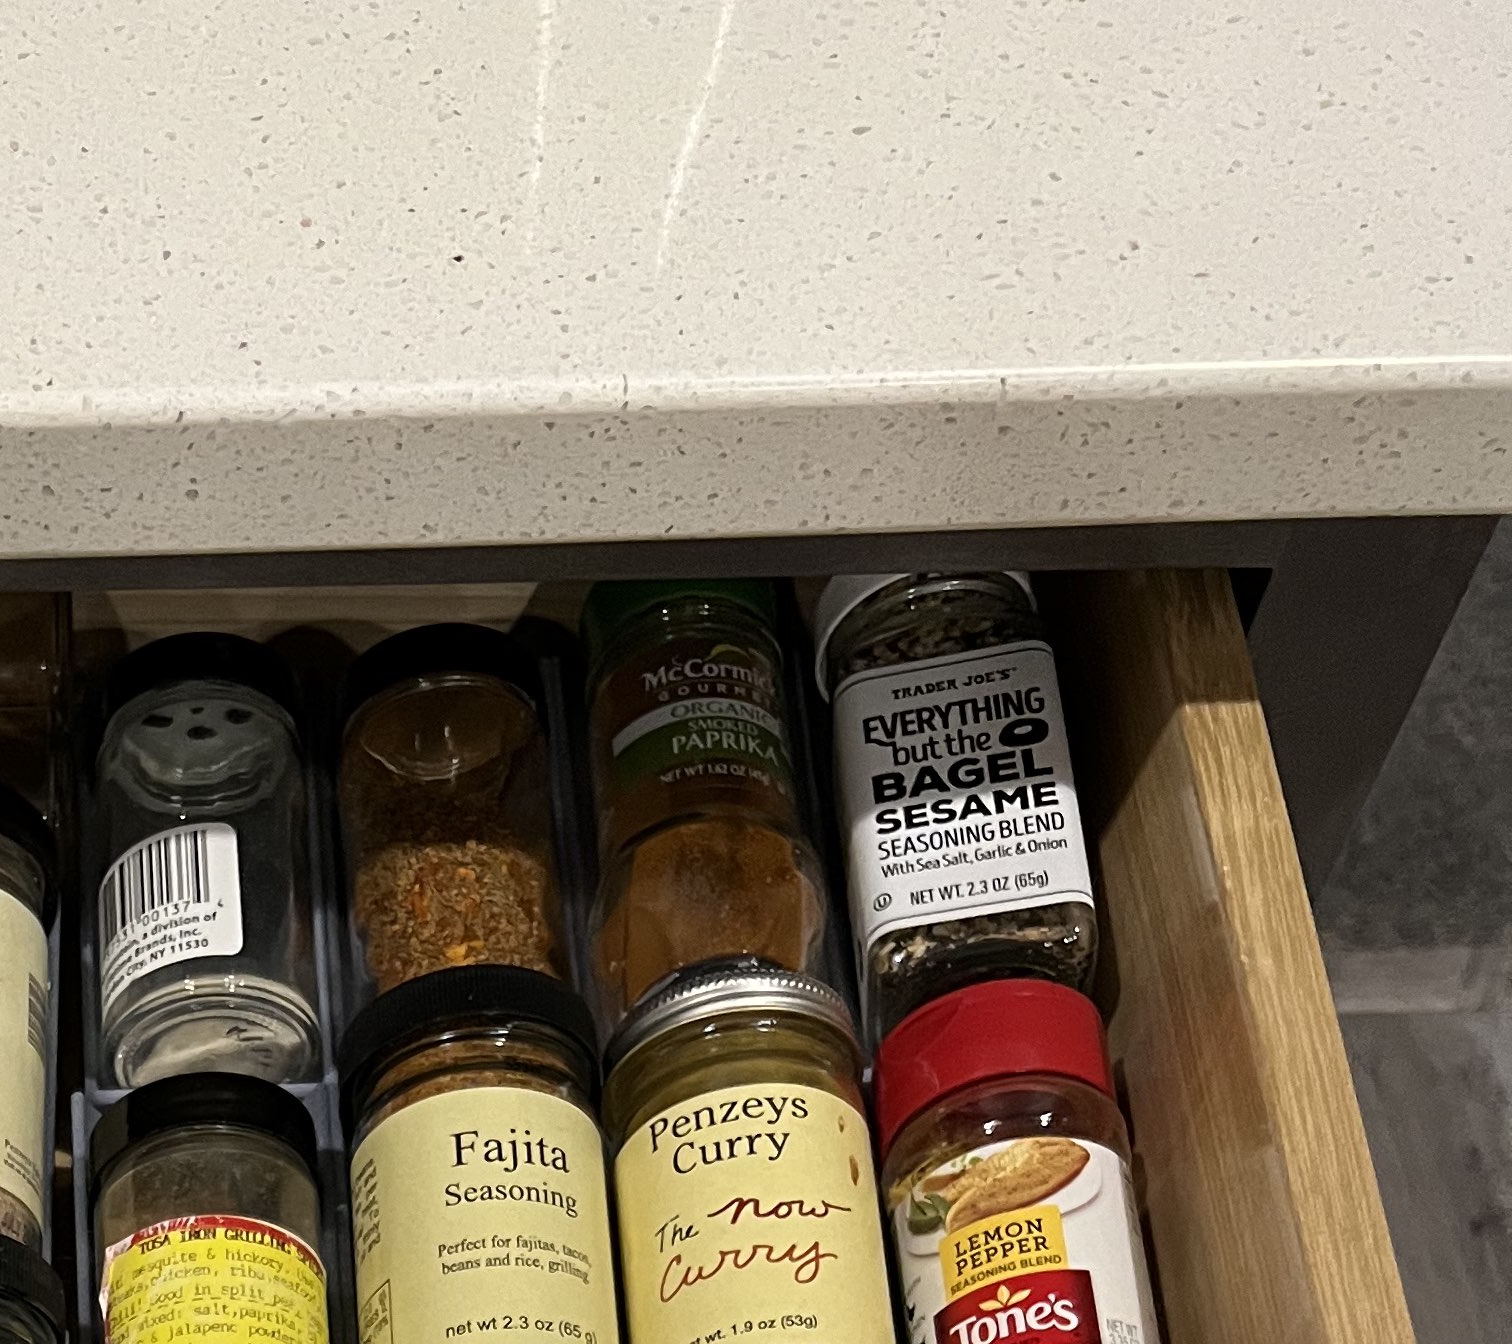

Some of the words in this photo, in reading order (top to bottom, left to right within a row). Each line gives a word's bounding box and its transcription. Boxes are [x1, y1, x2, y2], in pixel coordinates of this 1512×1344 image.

[892, 678, 958, 700] TRADER
[862, 687, 1045, 748] EVERYTHING
[672, 732, 779, 766] PAPRIKA
[892, 737, 943, 766] but
[944, 728, 992, 759] the
[871, 748, 1053, 804] BAGEL
[875, 781, 1058, 835] SESAME
[878, 821, 996, 860] SEASONING
[999, 811, 1065, 839] BLEND
[881, 862, 915, 878] With
[917, 857, 942, 873] Sea
[942, 850, 974, 869] Salt,
[975, 844, 1013, 862] Garlic
[1015, 842, 1025, 856] &
[1028, 837, 1068, 853] Onion
[910, 890, 935, 906] NET
[938, 885, 962, 902] WT.
[967, 881, 988, 898] 2.3
[993, 877, 1011, 893] OZ
[1014, 870, 1049, 891] (65g)
[648, 1096, 809, 1153] Penzeys
[449, 1128, 570, 1174] Fajita
[672, 1131, 790, 1175] Curry
[444, 1182, 579, 1219] Seasoning
[707, 1196, 851, 1224] now
[655, 1214, 700, 1253] The
[954, 1218, 1044, 1258] LEMON
[660, 1240, 838, 1303] Curry
[950, 1260, 1017, 1296] SEASONING
[1020, 1253, 1062, 1271] BLEND
[956, 1235, 1049, 1277] PEPPER
